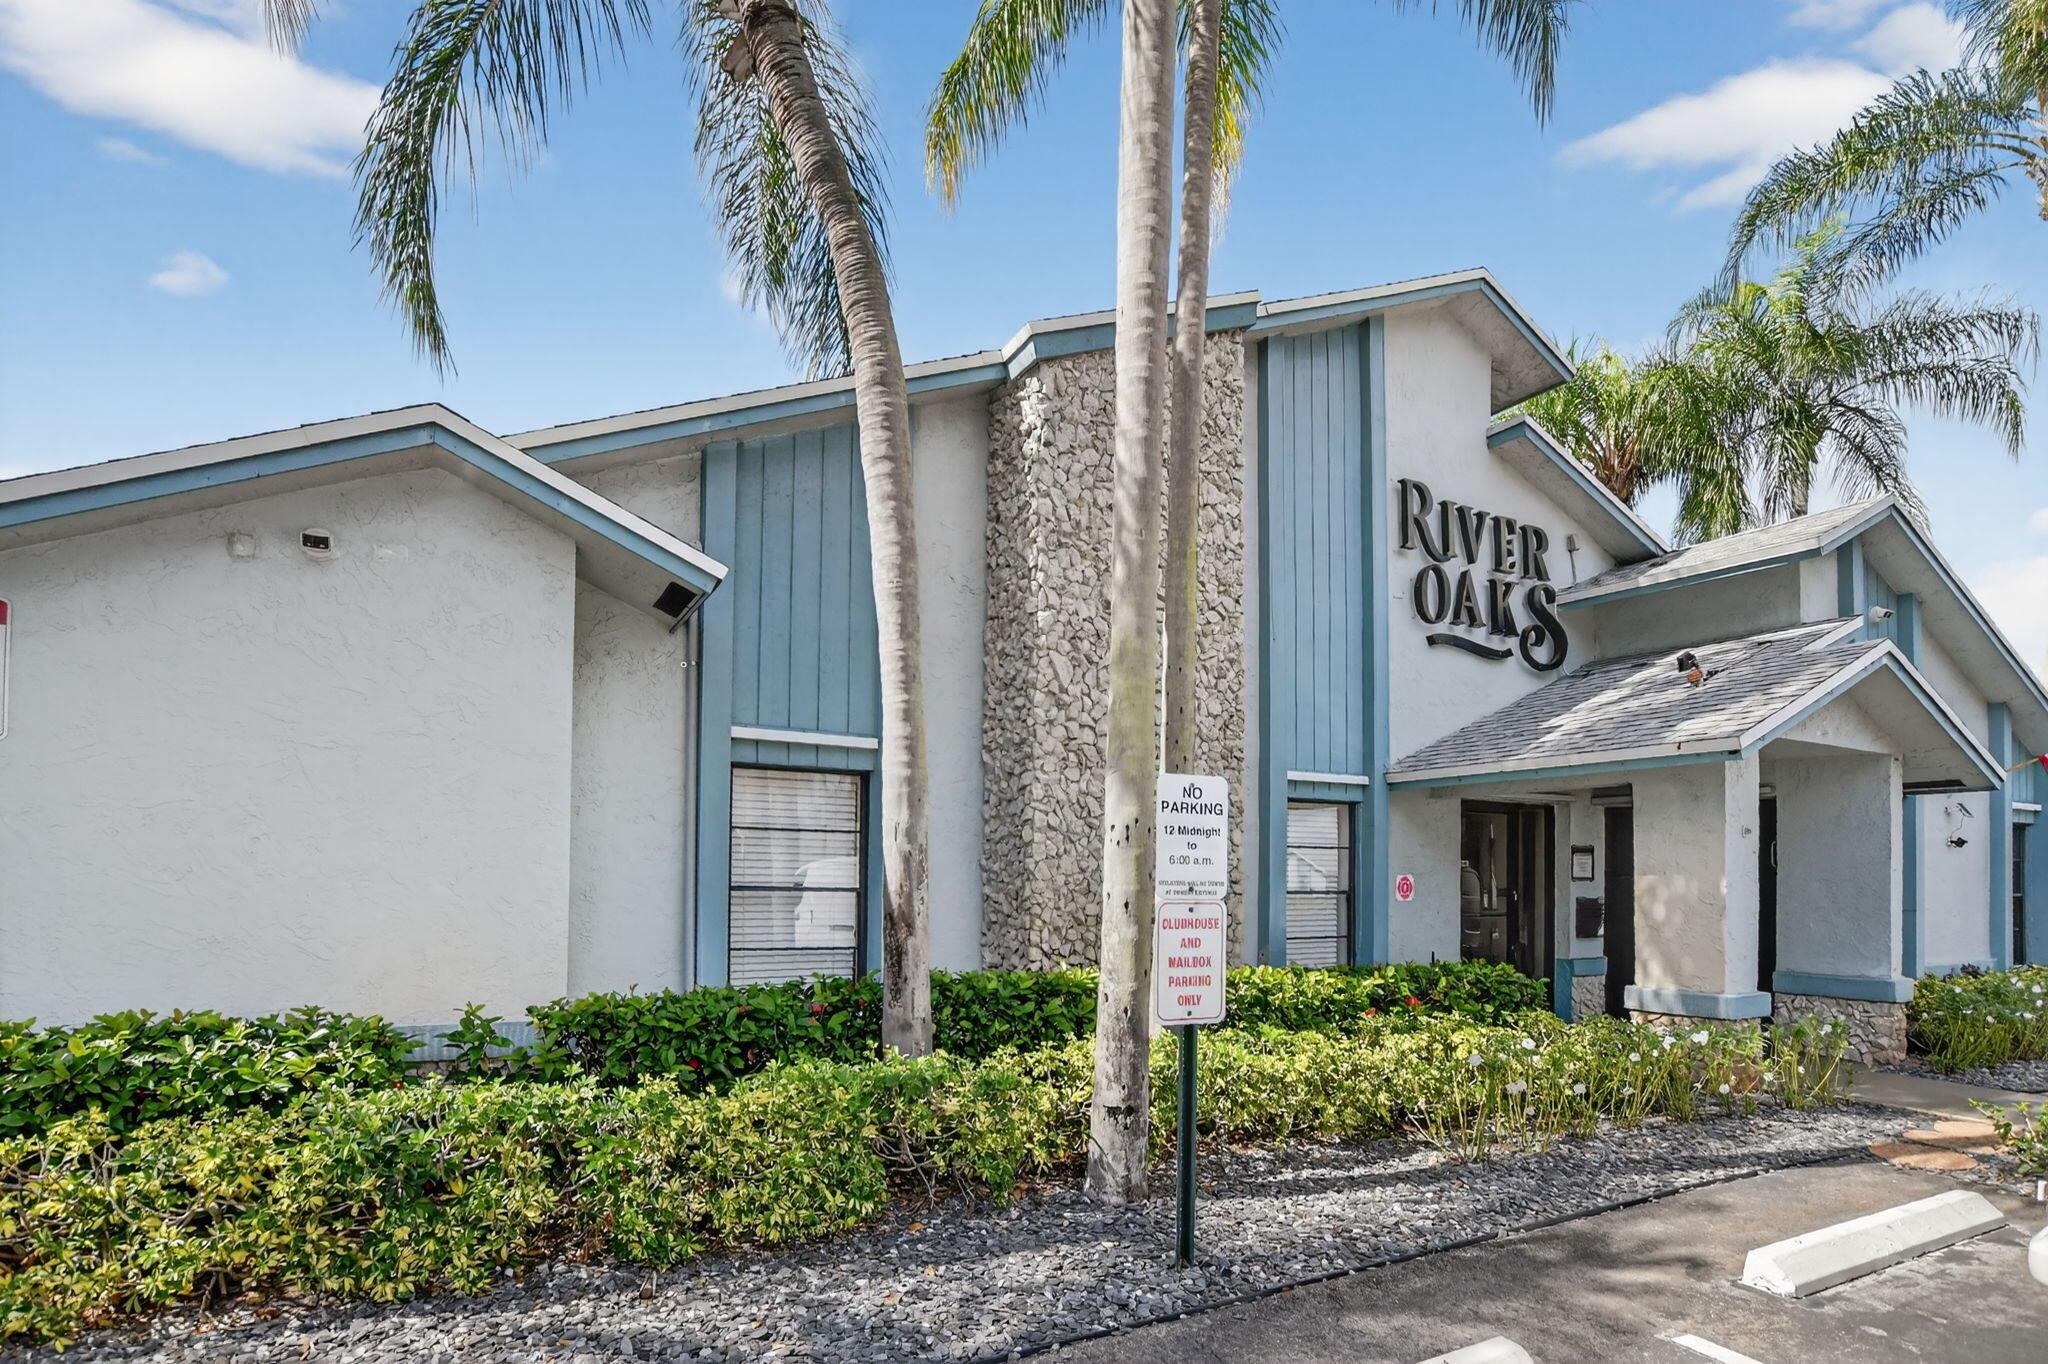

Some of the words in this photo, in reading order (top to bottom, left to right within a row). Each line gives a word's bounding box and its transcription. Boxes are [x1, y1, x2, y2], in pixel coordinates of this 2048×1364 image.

[1397, 477, 1551, 582] RIVER
[1413, 563, 1568, 672] OAKS
[1182, 786, 1203, 800] NO
[1161, 800, 1224, 816] PARKING
[1164, 825, 1175, 835] 12
[1178, 825, 1221, 839] Midnight
[1187, 841, 1197, 850] to
[1169, 855, 1190, 865] 6:00
[1193, 857, 1214, 865] a.m.
[1162, 918, 1221, 930] CLUBHOUSE
[1180, 937, 1201, 948] AND
[1168, 956, 1212, 968] MAILBOX
[1168, 975, 1212, 987] PARKING
[1177, 994, 1202, 1006] ONLY
